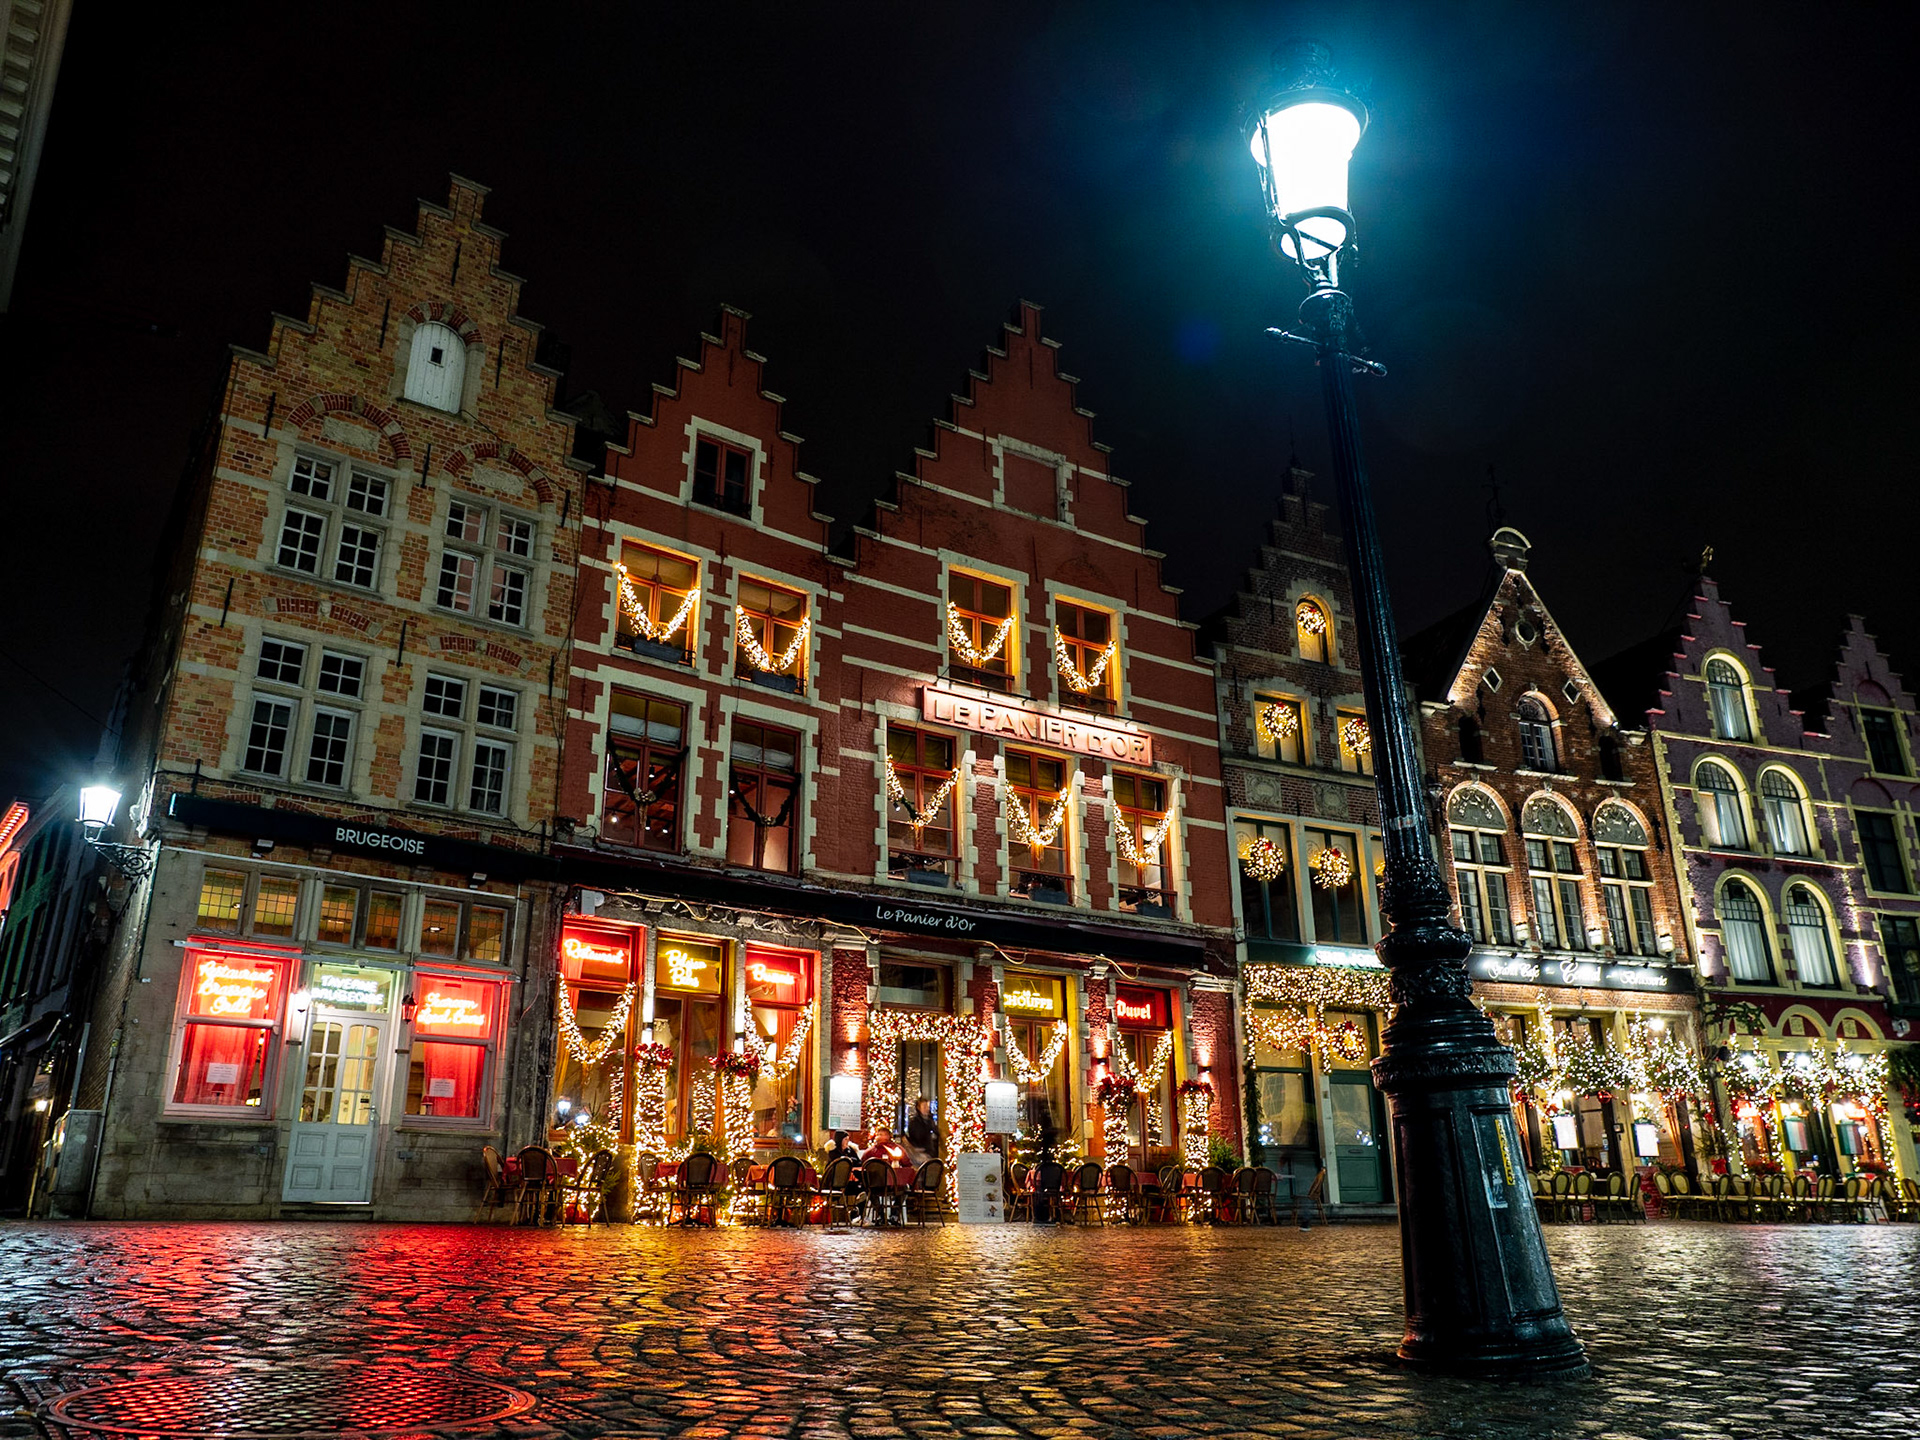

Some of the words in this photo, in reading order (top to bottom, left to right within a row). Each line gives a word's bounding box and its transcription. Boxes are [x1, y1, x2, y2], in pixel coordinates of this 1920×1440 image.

[934, 698, 970, 725] LE
[979, 703, 1077, 748] PANIER
[1086, 731, 1145, 762] D'OR
[335, 827, 425, 855] BRUGEOISE
[876, 905, 894, 920] Le
[894, 909, 943, 927] Panier
[945, 915, 976, 931] d'Or
[199, 960, 275, 983] Restaurant
[321, 975, 379, 993] TAVERNE
[311, 987, 385, 1006] BRUGEOISE
[1116, 999, 1152, 1020] Duvel
